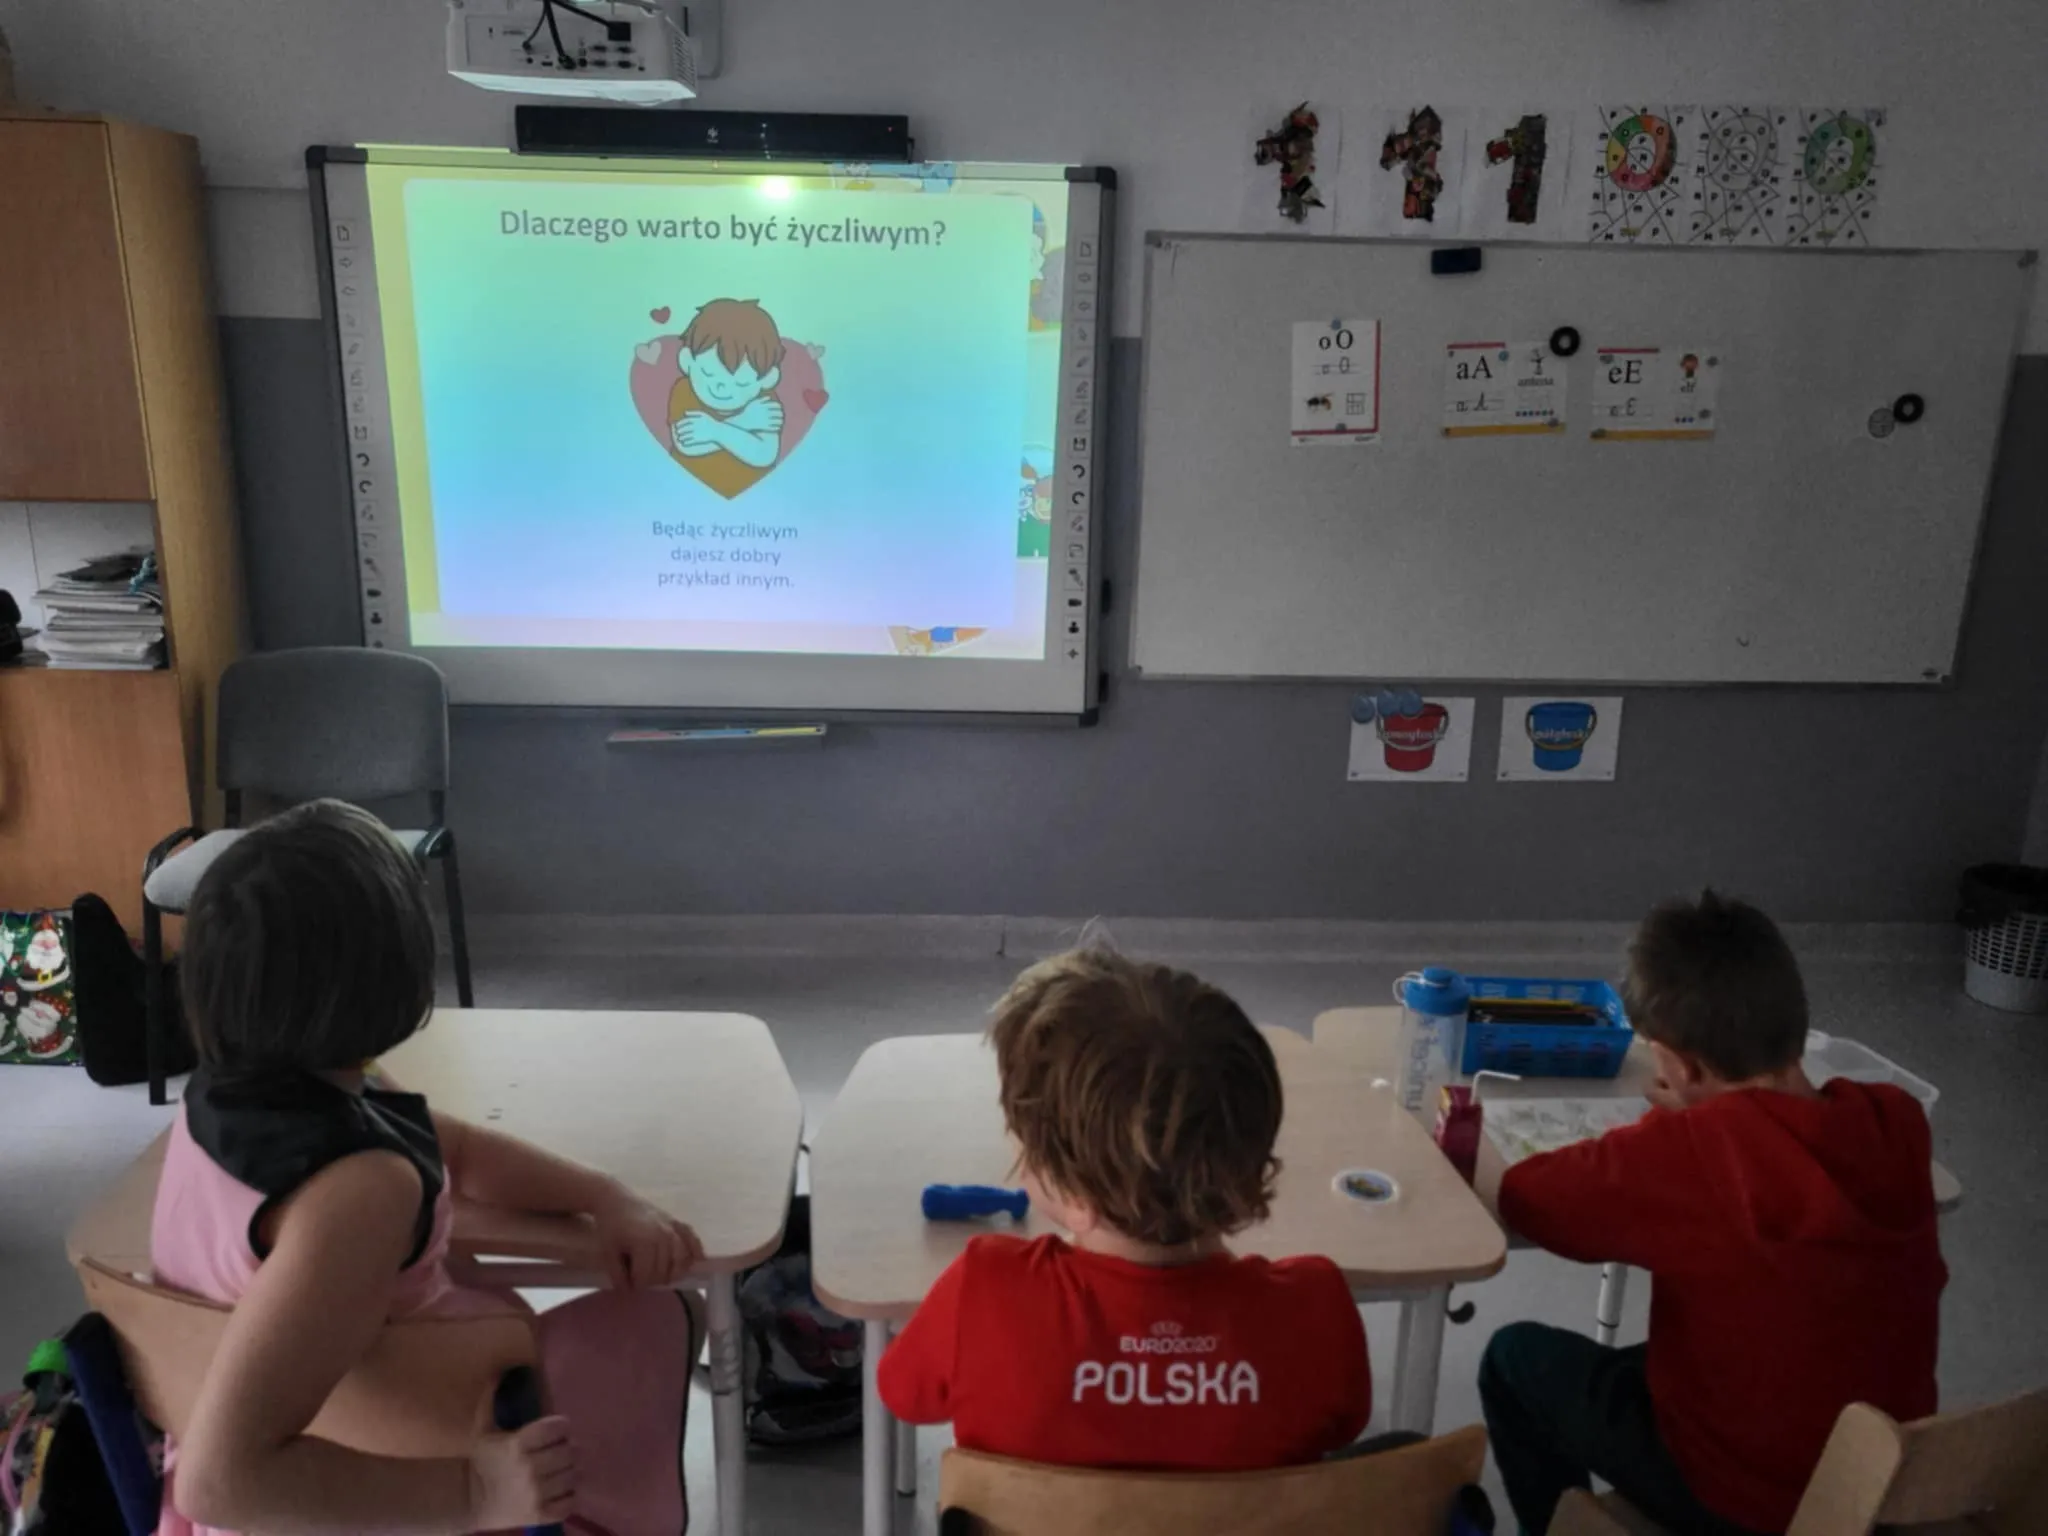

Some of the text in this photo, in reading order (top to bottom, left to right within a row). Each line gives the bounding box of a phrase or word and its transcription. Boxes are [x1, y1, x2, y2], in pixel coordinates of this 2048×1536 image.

[501, 209, 946, 251] Dlaczego warto być życzliwym?
[1455, 355, 1493, 380] aA
[1608, 359, 1643, 384] eE
[652, 521, 799, 541] Będąc życzliwym
[671, 547, 781, 566] dajesz dobry
[658, 569, 795, 590] przykład innym.
[1119, 1335, 1217, 1354] EURO2020
[1072, 1359, 1260, 1406] POLSKA
